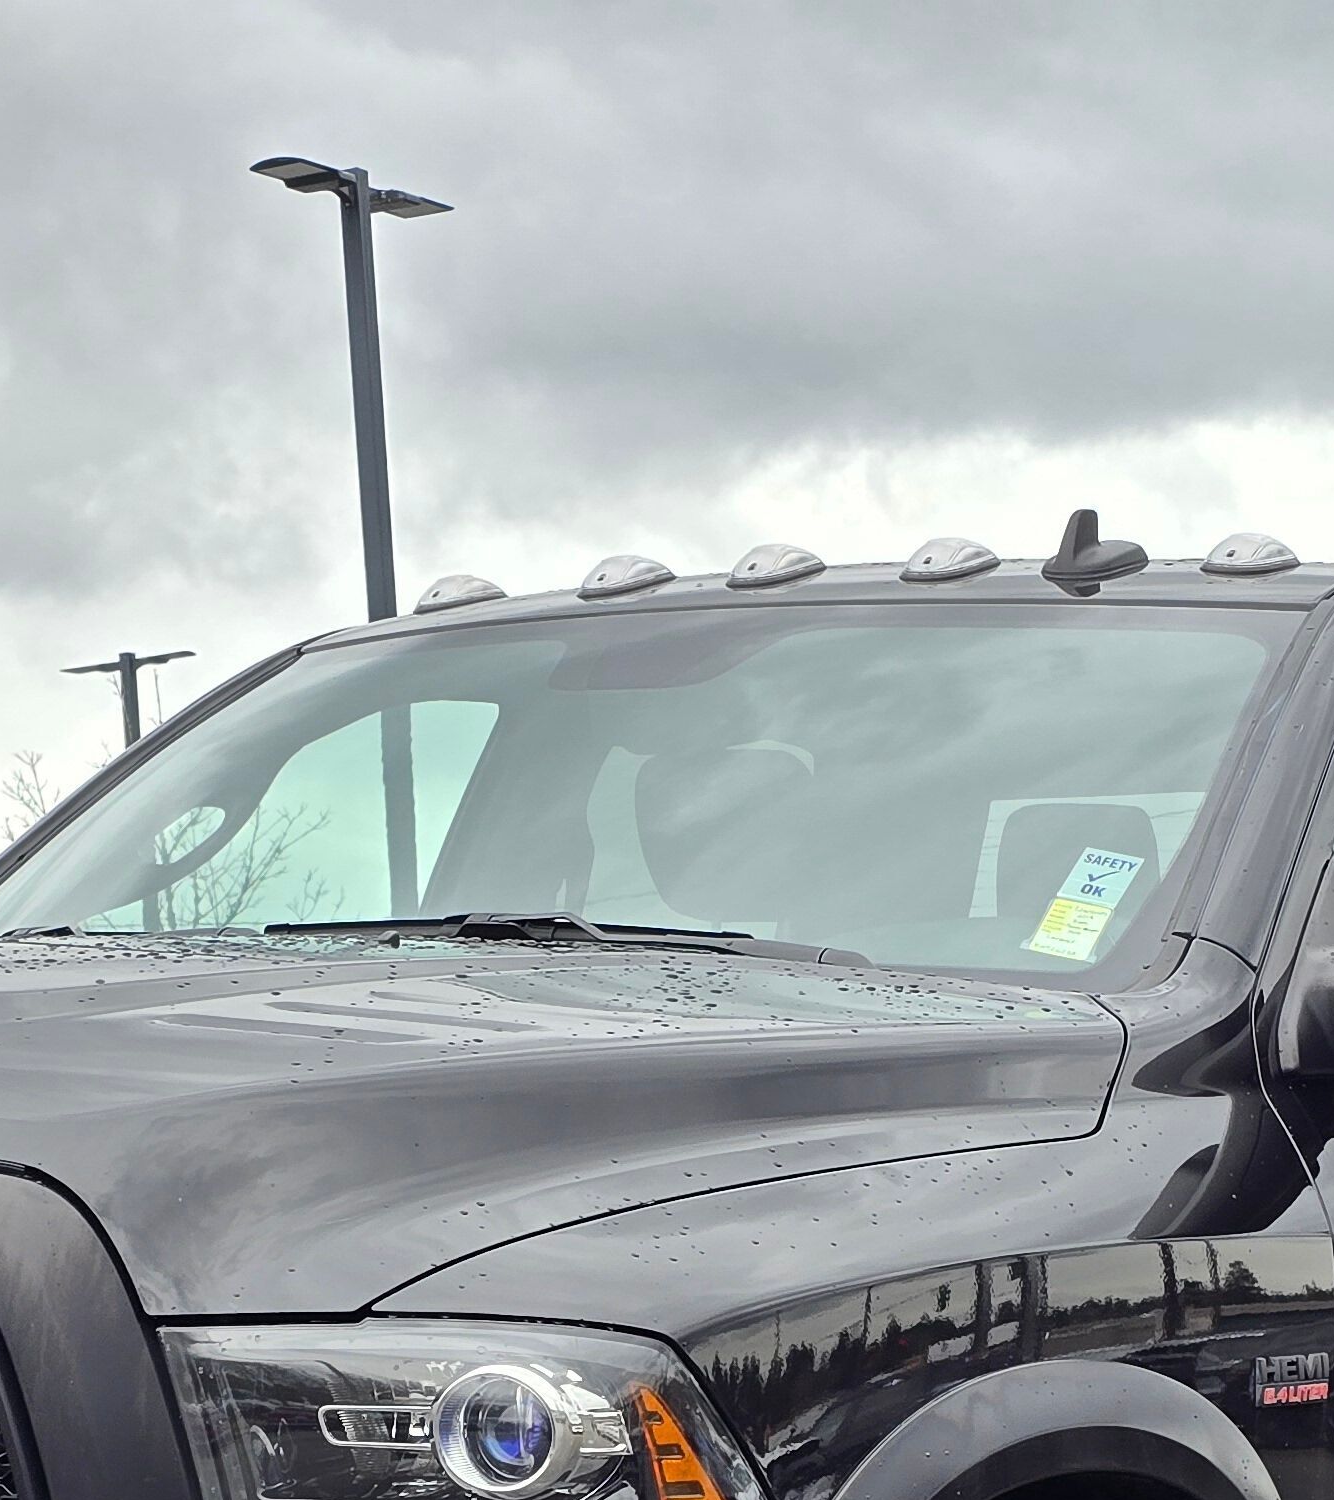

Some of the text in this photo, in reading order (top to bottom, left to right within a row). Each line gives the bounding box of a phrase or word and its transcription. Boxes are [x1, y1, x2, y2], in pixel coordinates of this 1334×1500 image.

[1083, 853, 1138, 873] SAFETY
[1080, 883, 1107, 898] OK
[1255, 1352, 1329, 1383] HEMI
[1288, 1382, 1329, 1403] LITER
